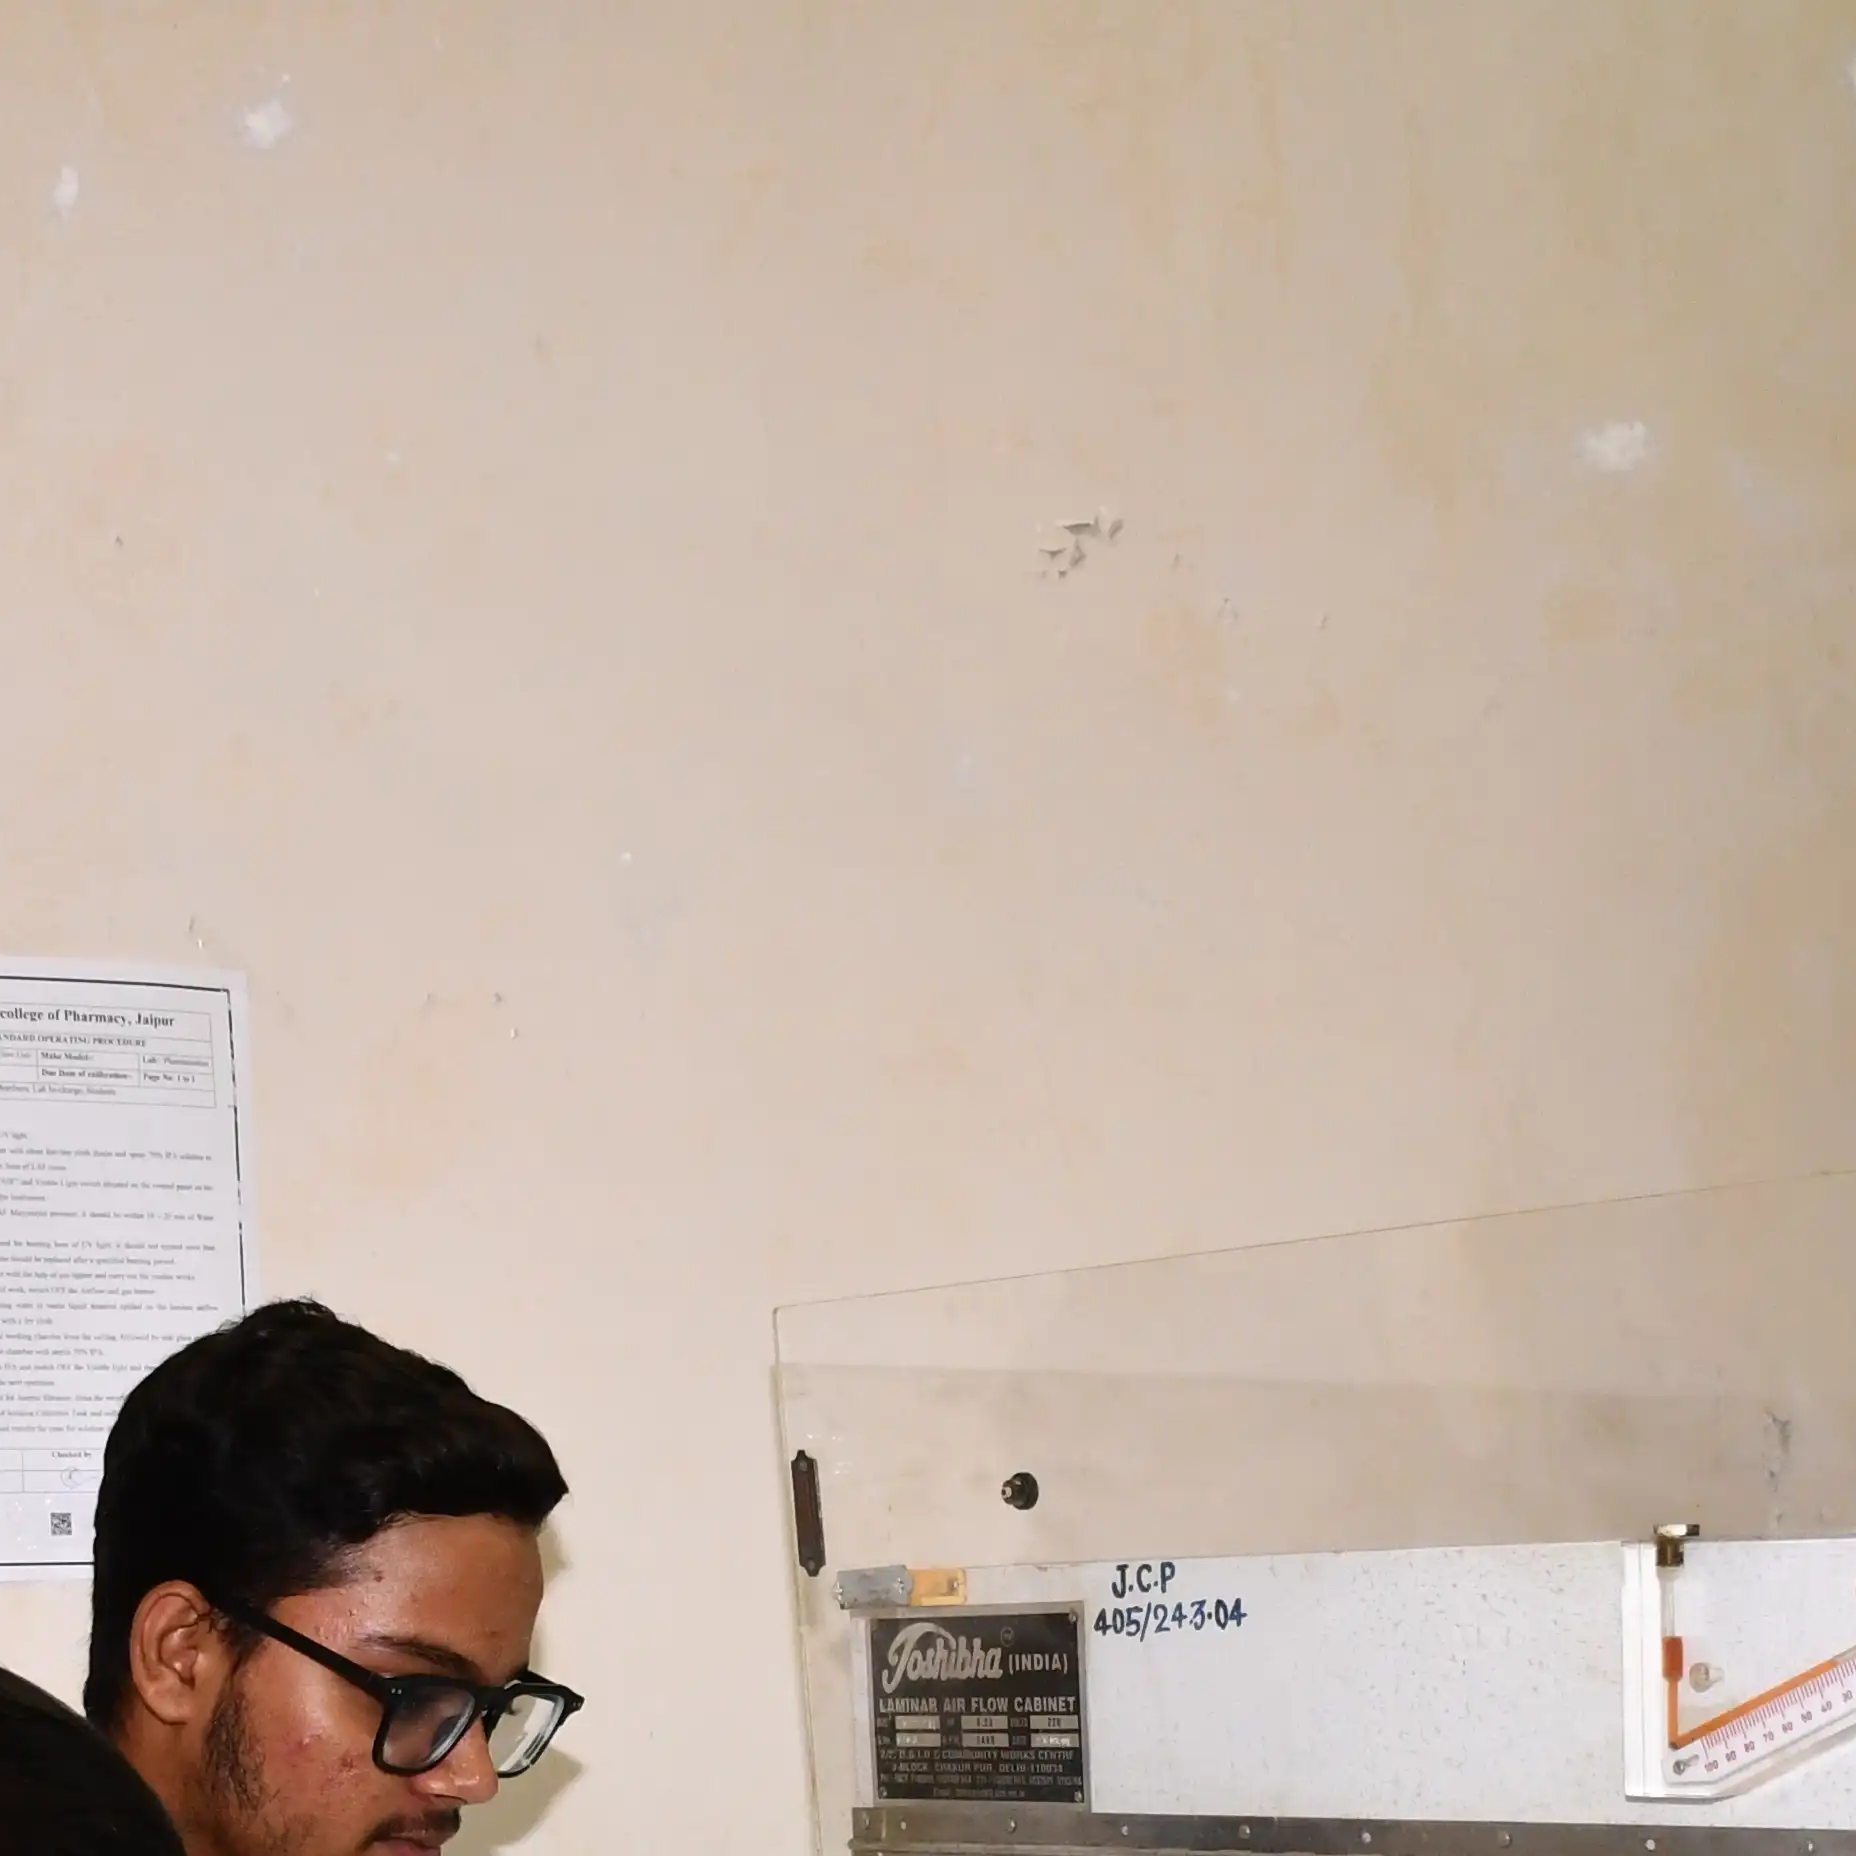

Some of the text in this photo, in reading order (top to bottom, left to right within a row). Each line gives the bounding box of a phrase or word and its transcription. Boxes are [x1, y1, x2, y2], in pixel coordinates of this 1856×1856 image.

[0, 1008, 43, 1021] college
[48, 1009, 60, 1020] of
[64, 1010, 132, 1026] Pharmacy,
[136, 1012, 175, 1028] Jaipur
[882, 1622, 1003, 1694] Toshibha
[1008, 1653, 1068, 1676] (INDIA)
[880, 1696, 1076, 1713] LAMINAR AIR FLOW CABINET
[1763, 1731, 1774, 1742] 70
